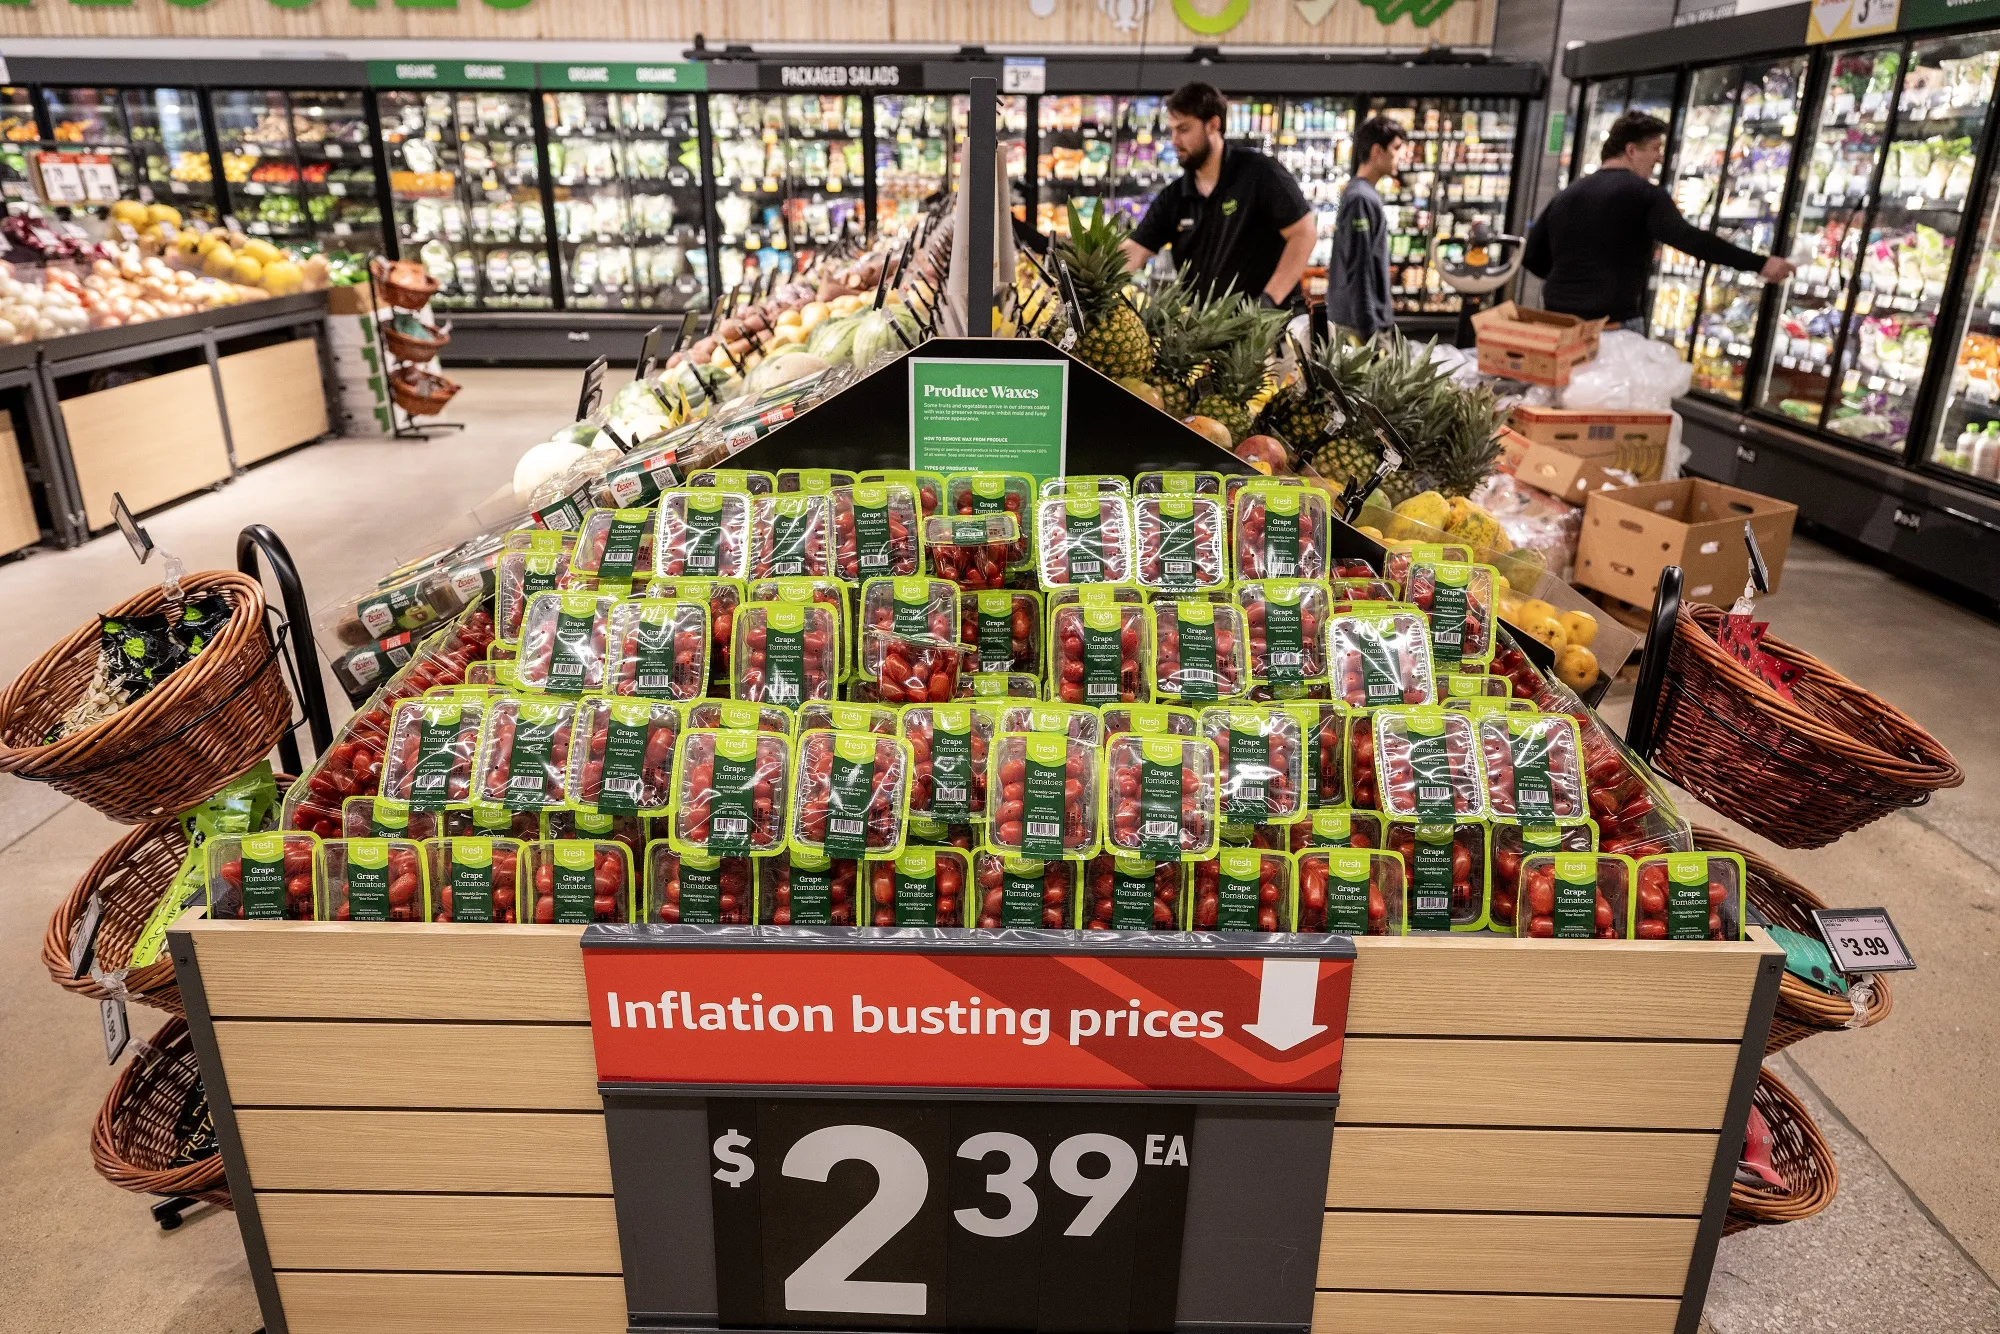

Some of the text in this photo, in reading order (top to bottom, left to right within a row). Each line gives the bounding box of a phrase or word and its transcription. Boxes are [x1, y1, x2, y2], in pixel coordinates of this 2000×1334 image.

[782, 66, 899, 86] PACKAGED SALADS
[924, 384, 1039, 399] Produce Waxes
[731, 434, 752, 447] Zespri
[615, 480, 636, 492] Zespri
[1273, 497, 1292, 505] fresh
[1442, 568, 1461, 576] fresh
[457, 576, 476, 588] Zespri
[1186, 608, 1205, 616] fresh
[366, 612, 387, 622] Zespri
[775, 613, 795, 621] fresh
[1092, 635, 1113, 643] Grape
[768, 643, 801, 651] Tomatoes
[353, 660, 374, 671] Zespri
[616, 729, 638, 737] Grape
[609, 737, 644, 745] Tomatoes
[725, 740, 748, 749] fresh
[941, 738, 963, 746] Grape
[1036, 744, 1058, 753] fresh
[1151, 744, 1173, 753] fresh
[1232, 746, 1267, 754] Tomatoes
[723, 765, 746, 773] Grape
[1151, 769, 1173, 777] Grape
[1034, 770, 1057, 778] Grape
[1028, 778, 1063, 786] Tomatoes
[1144, 777, 1179, 785] Tomatoes
[251, 841, 274, 850] fresh
[357, 847, 379, 856] fresh
[1422, 848, 1445, 856] Grape
[904, 856, 927, 866] fresh
[1416, 855, 1451, 863] Tomatoes
[251, 867, 275, 875] Grape
[1677, 864, 1698, 873] fresh
[245, 874, 282, 882] Tomatoes
[356, 873, 379, 881] Grape
[460, 872, 483, 880] Grape
[682, 882, 717, 890] Tomatoes
[904, 883, 927, 891] Grape
[1012, 882, 1034, 890] Grape
[1122, 882, 1146, 890] Grape
[1228, 884, 1250, 892] Grape
[1337, 885, 1360, 893] Grape
[1005, 890, 1041, 898] Tomatoes
[1116, 889, 1152, 897] Tomatoes
[1221, 892, 1257, 900] Tomatoes
[1330, 893, 1367, 901] Tomatoes
[1678, 890, 1700, 898] Grape
[1557, 896, 1594, 904] Tomatoes
[1671, 898, 1707, 906] Tomatoes
[1840, 937, 1889, 956] $3.99
[606, 991, 1225, 1047] Inflation busting prices
[712, 1124, 1189, 1315] $ 2 39 EA
